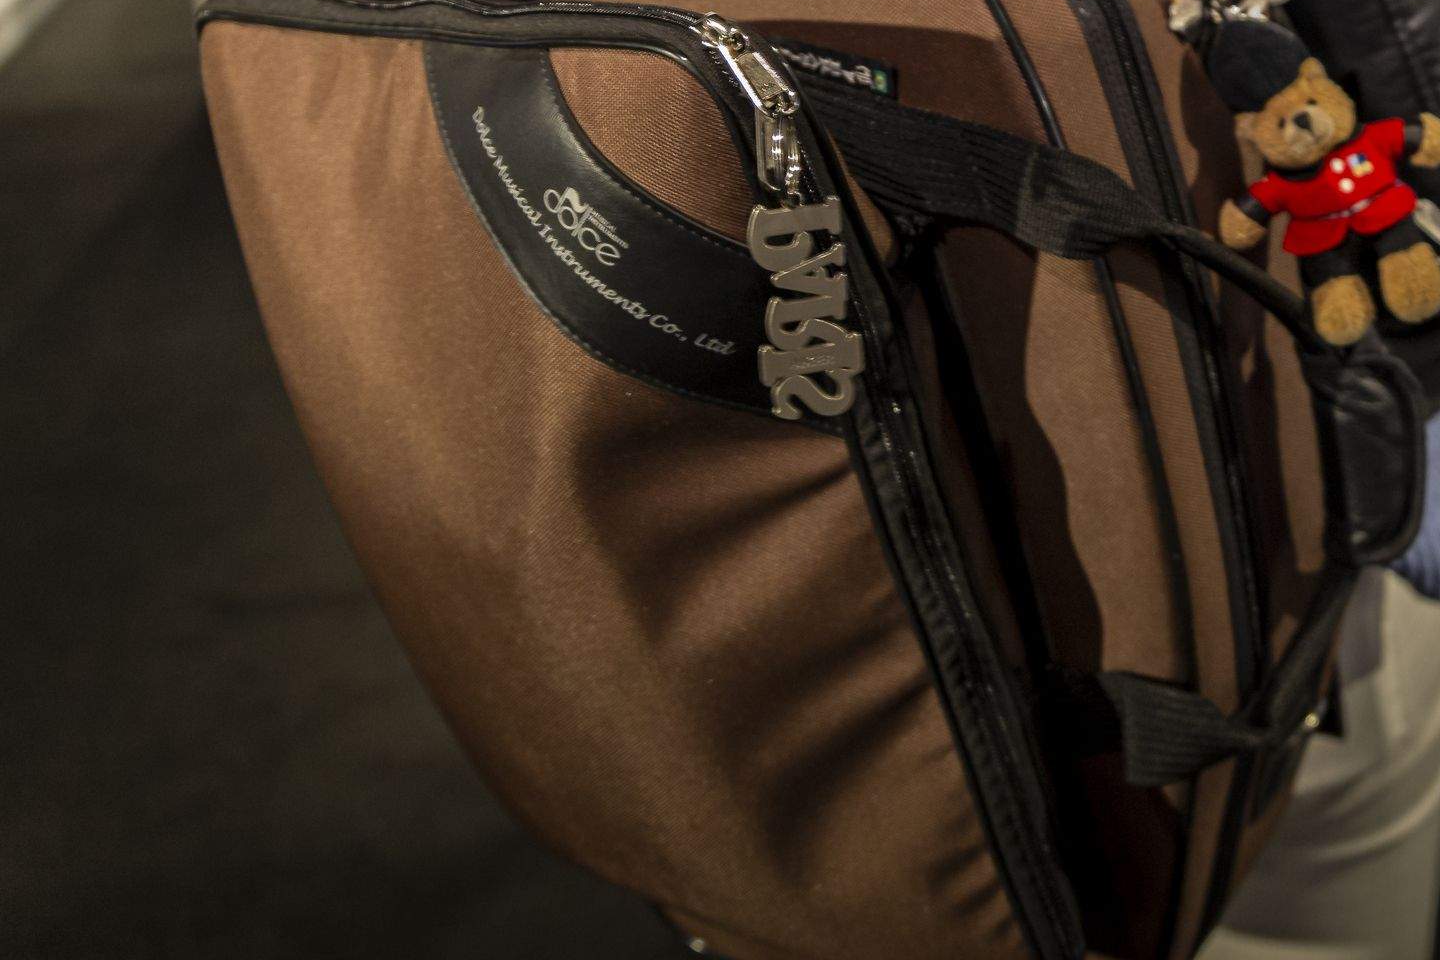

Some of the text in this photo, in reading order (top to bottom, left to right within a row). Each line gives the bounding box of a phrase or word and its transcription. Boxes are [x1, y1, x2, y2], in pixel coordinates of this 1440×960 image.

[493, 154, 543, 227] Musical
[538, 223, 651, 320] Instruments
[693, 333, 737, 356] Ltd
